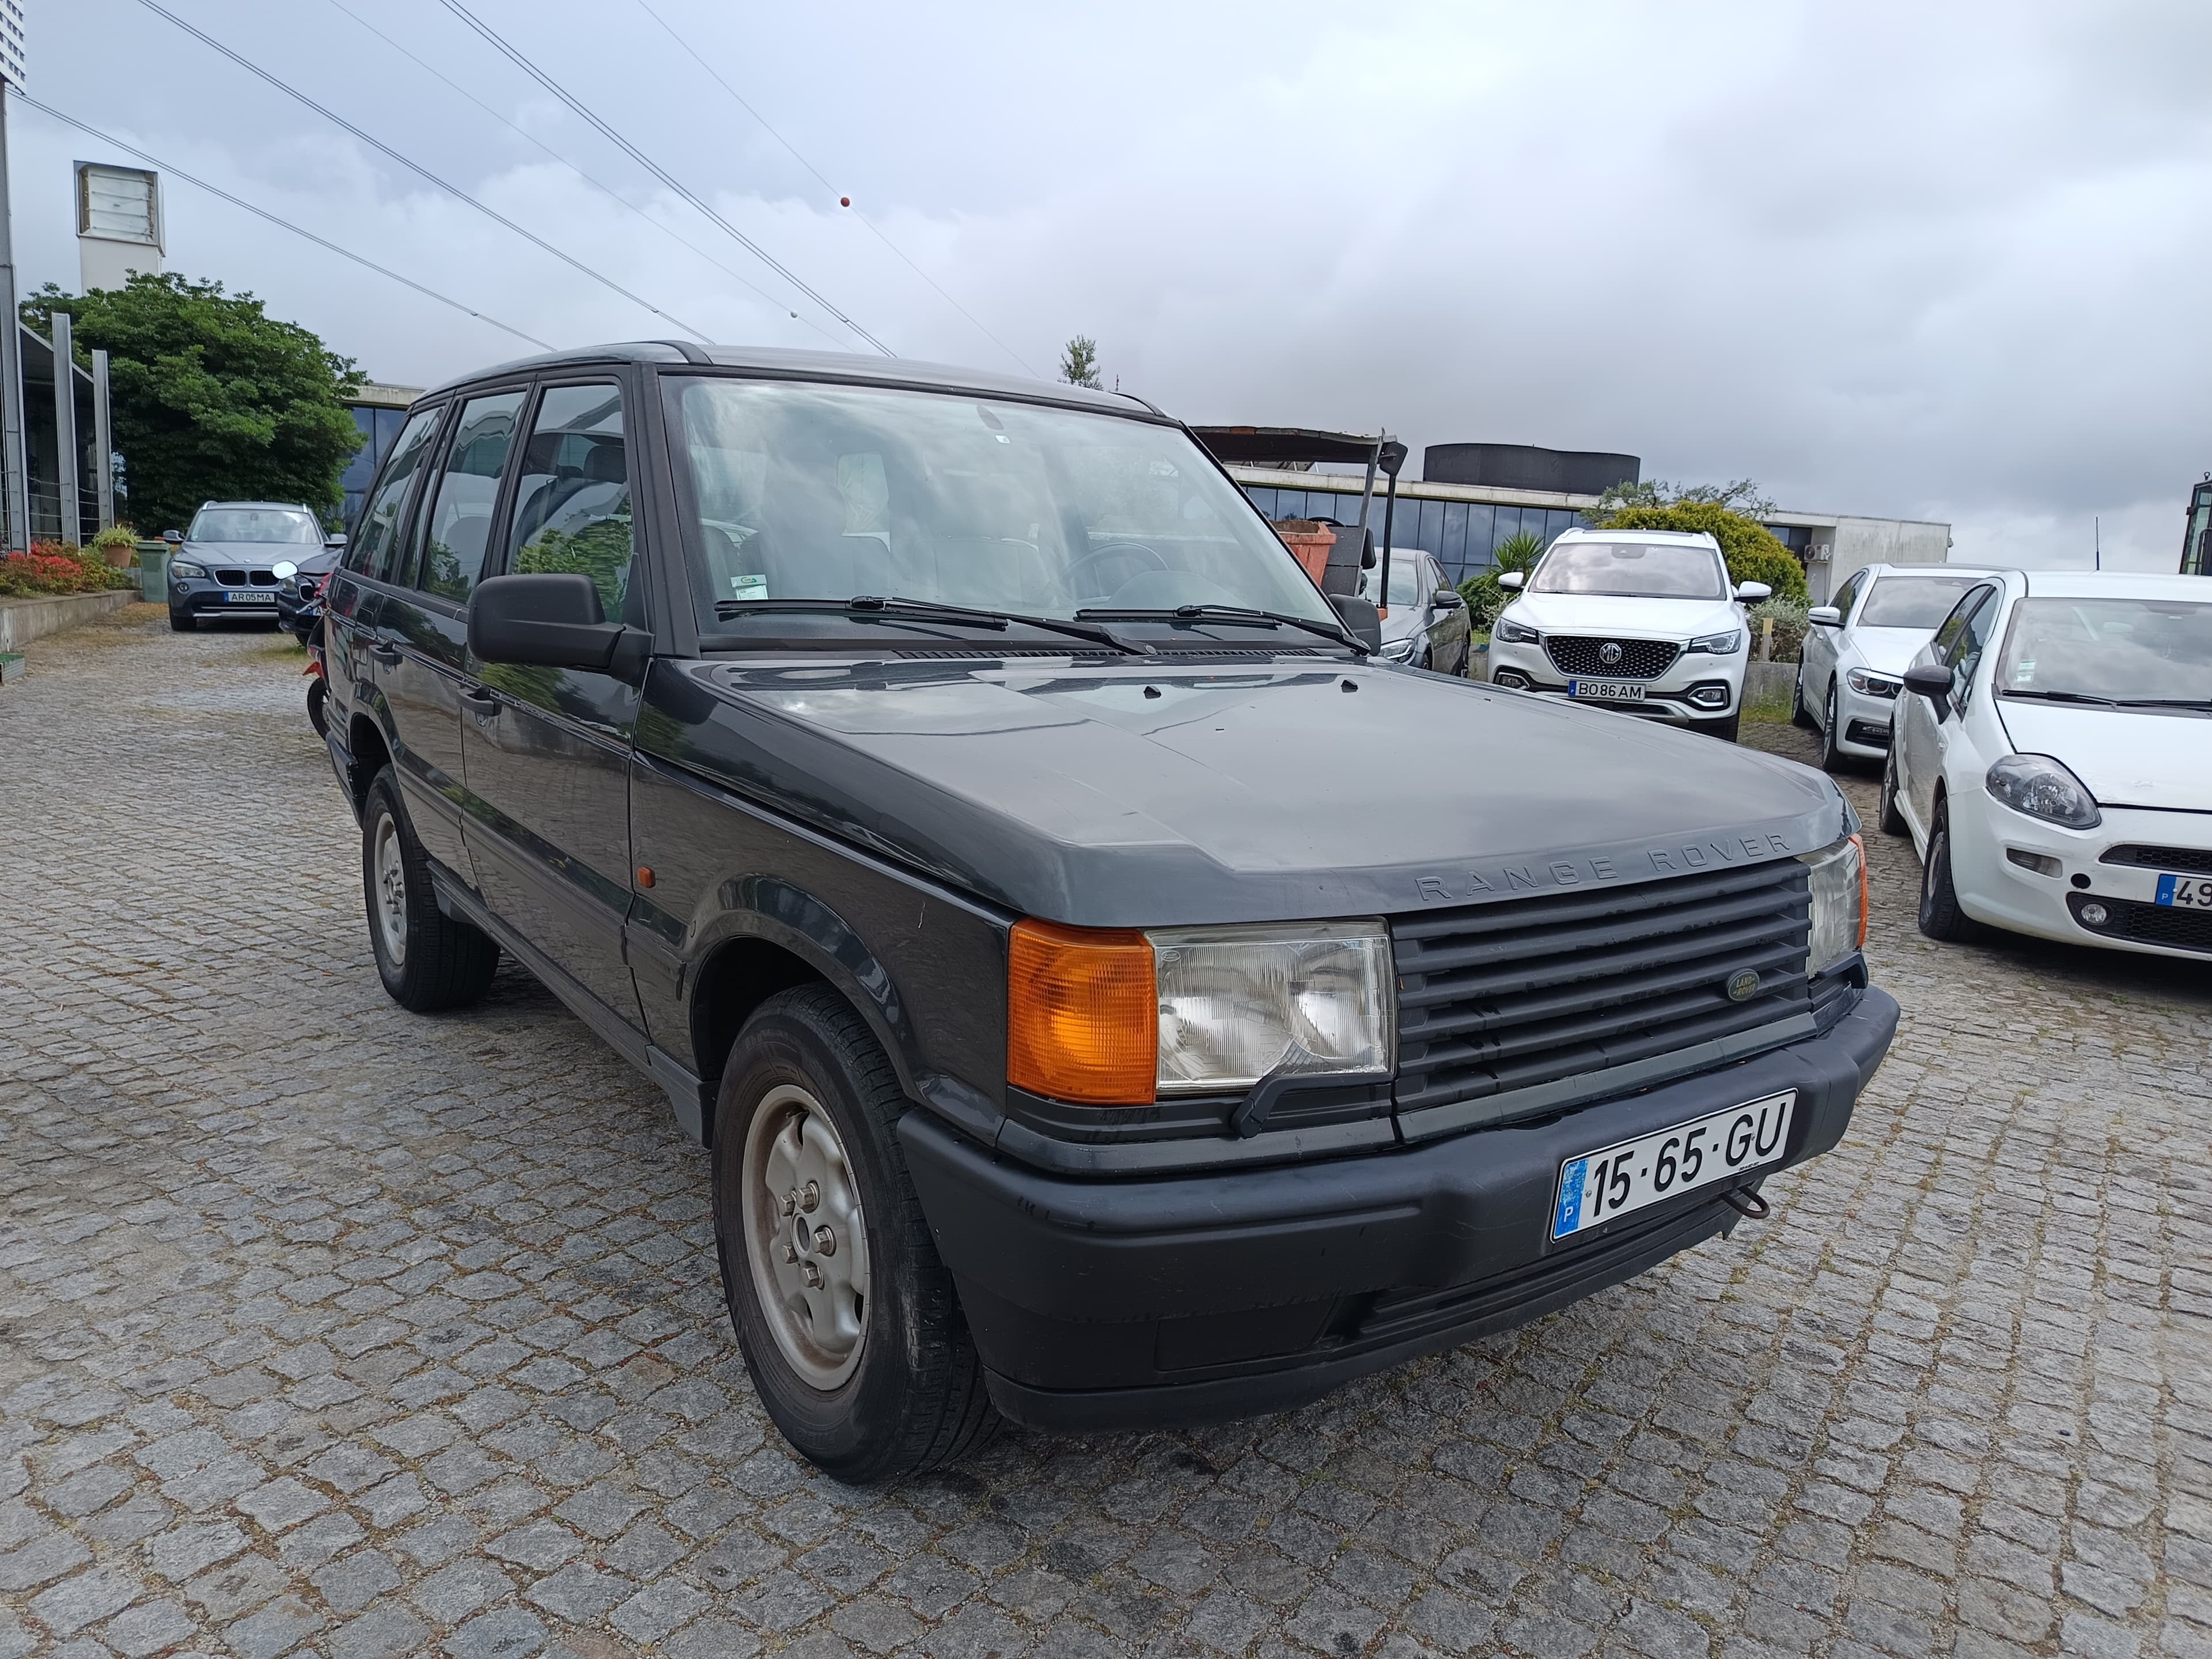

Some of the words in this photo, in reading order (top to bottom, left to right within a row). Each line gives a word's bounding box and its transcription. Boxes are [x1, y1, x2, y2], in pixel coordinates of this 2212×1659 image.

[1603, 645, 1619, 661] MG
[1414, 855, 1619, 901] RANGE
[1646, 833, 1790, 872] ROVER
[1736, 976, 1752, 988] LAND
[1563, 1206, 1574, 1222] P
